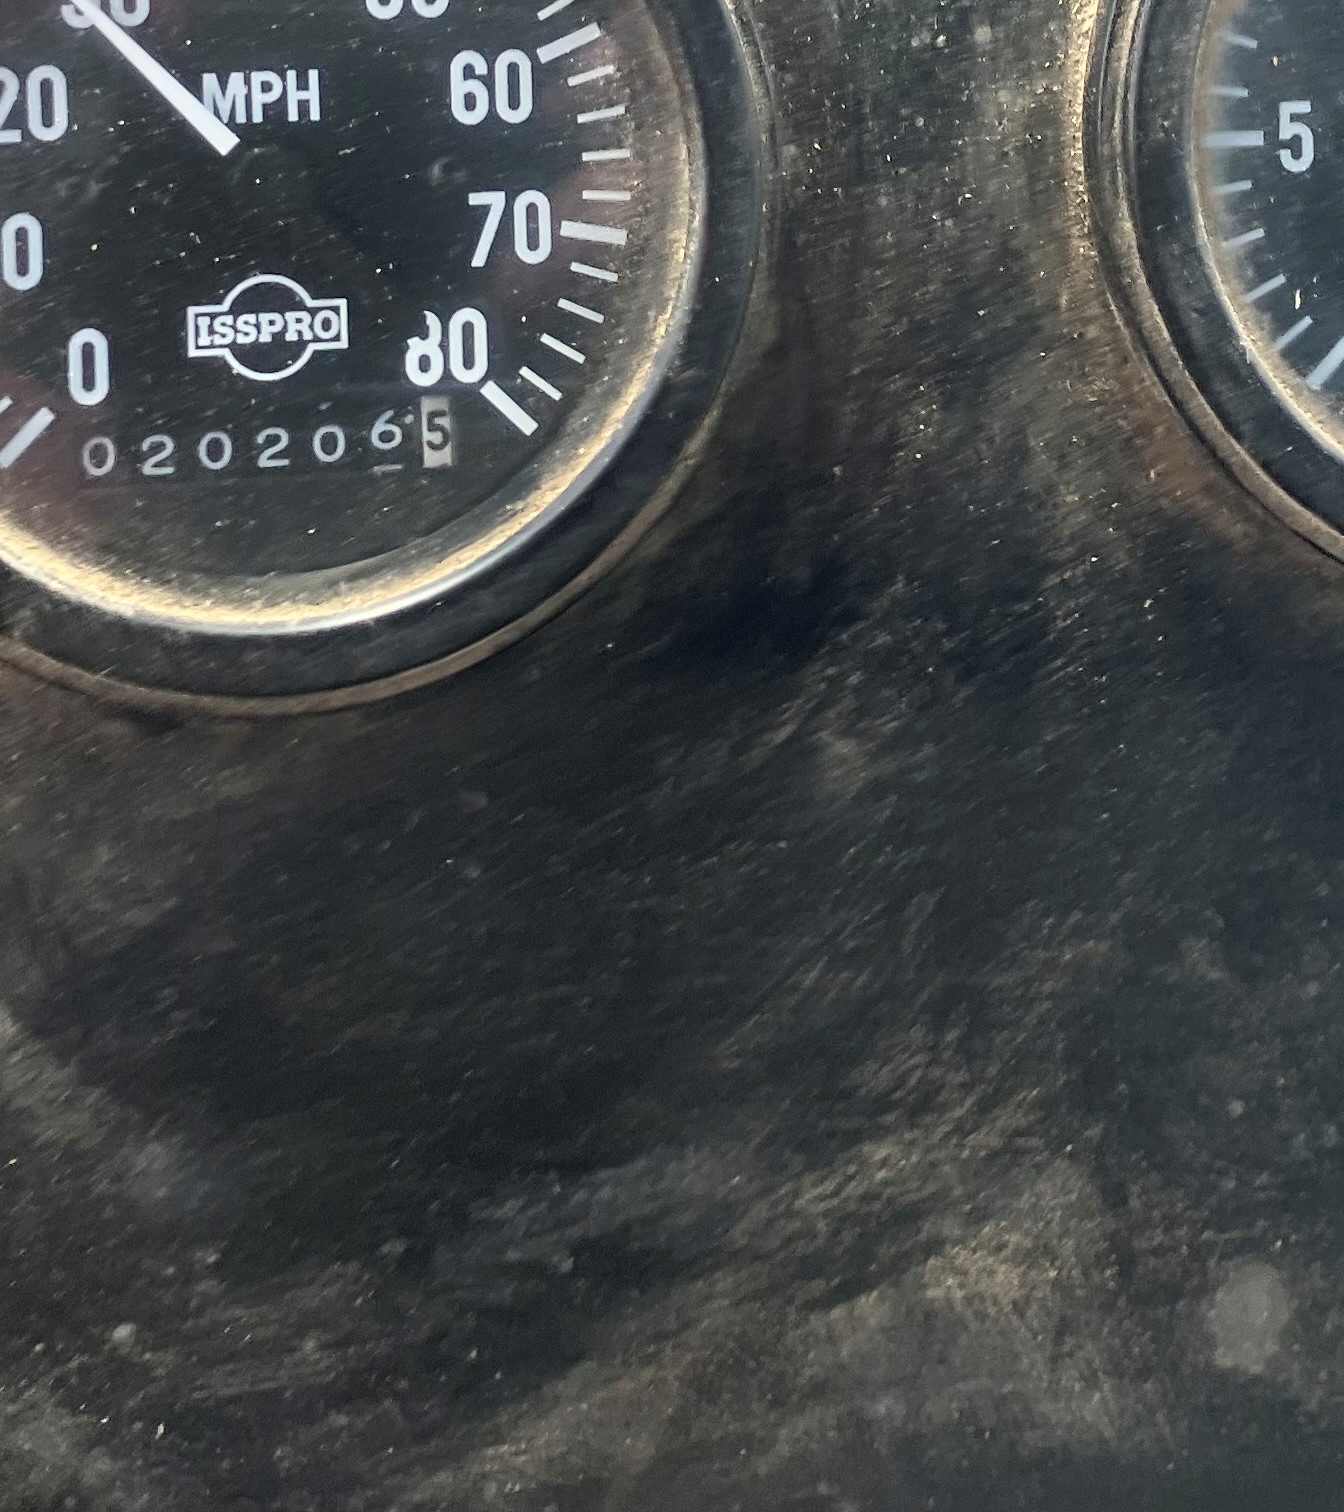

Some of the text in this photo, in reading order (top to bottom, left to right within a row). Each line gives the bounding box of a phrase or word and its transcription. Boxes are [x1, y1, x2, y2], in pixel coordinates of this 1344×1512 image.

[202, 69, 321, 124] MPH
[450, 49, 534, 124] 60
[1277, 100, 1316, 173] 5
[468, 189, 552, 267] 70
[196, 309, 341, 347] ISSPRO
[404, 306, 490, 387] 80
[66, 327, 110, 406] 0
